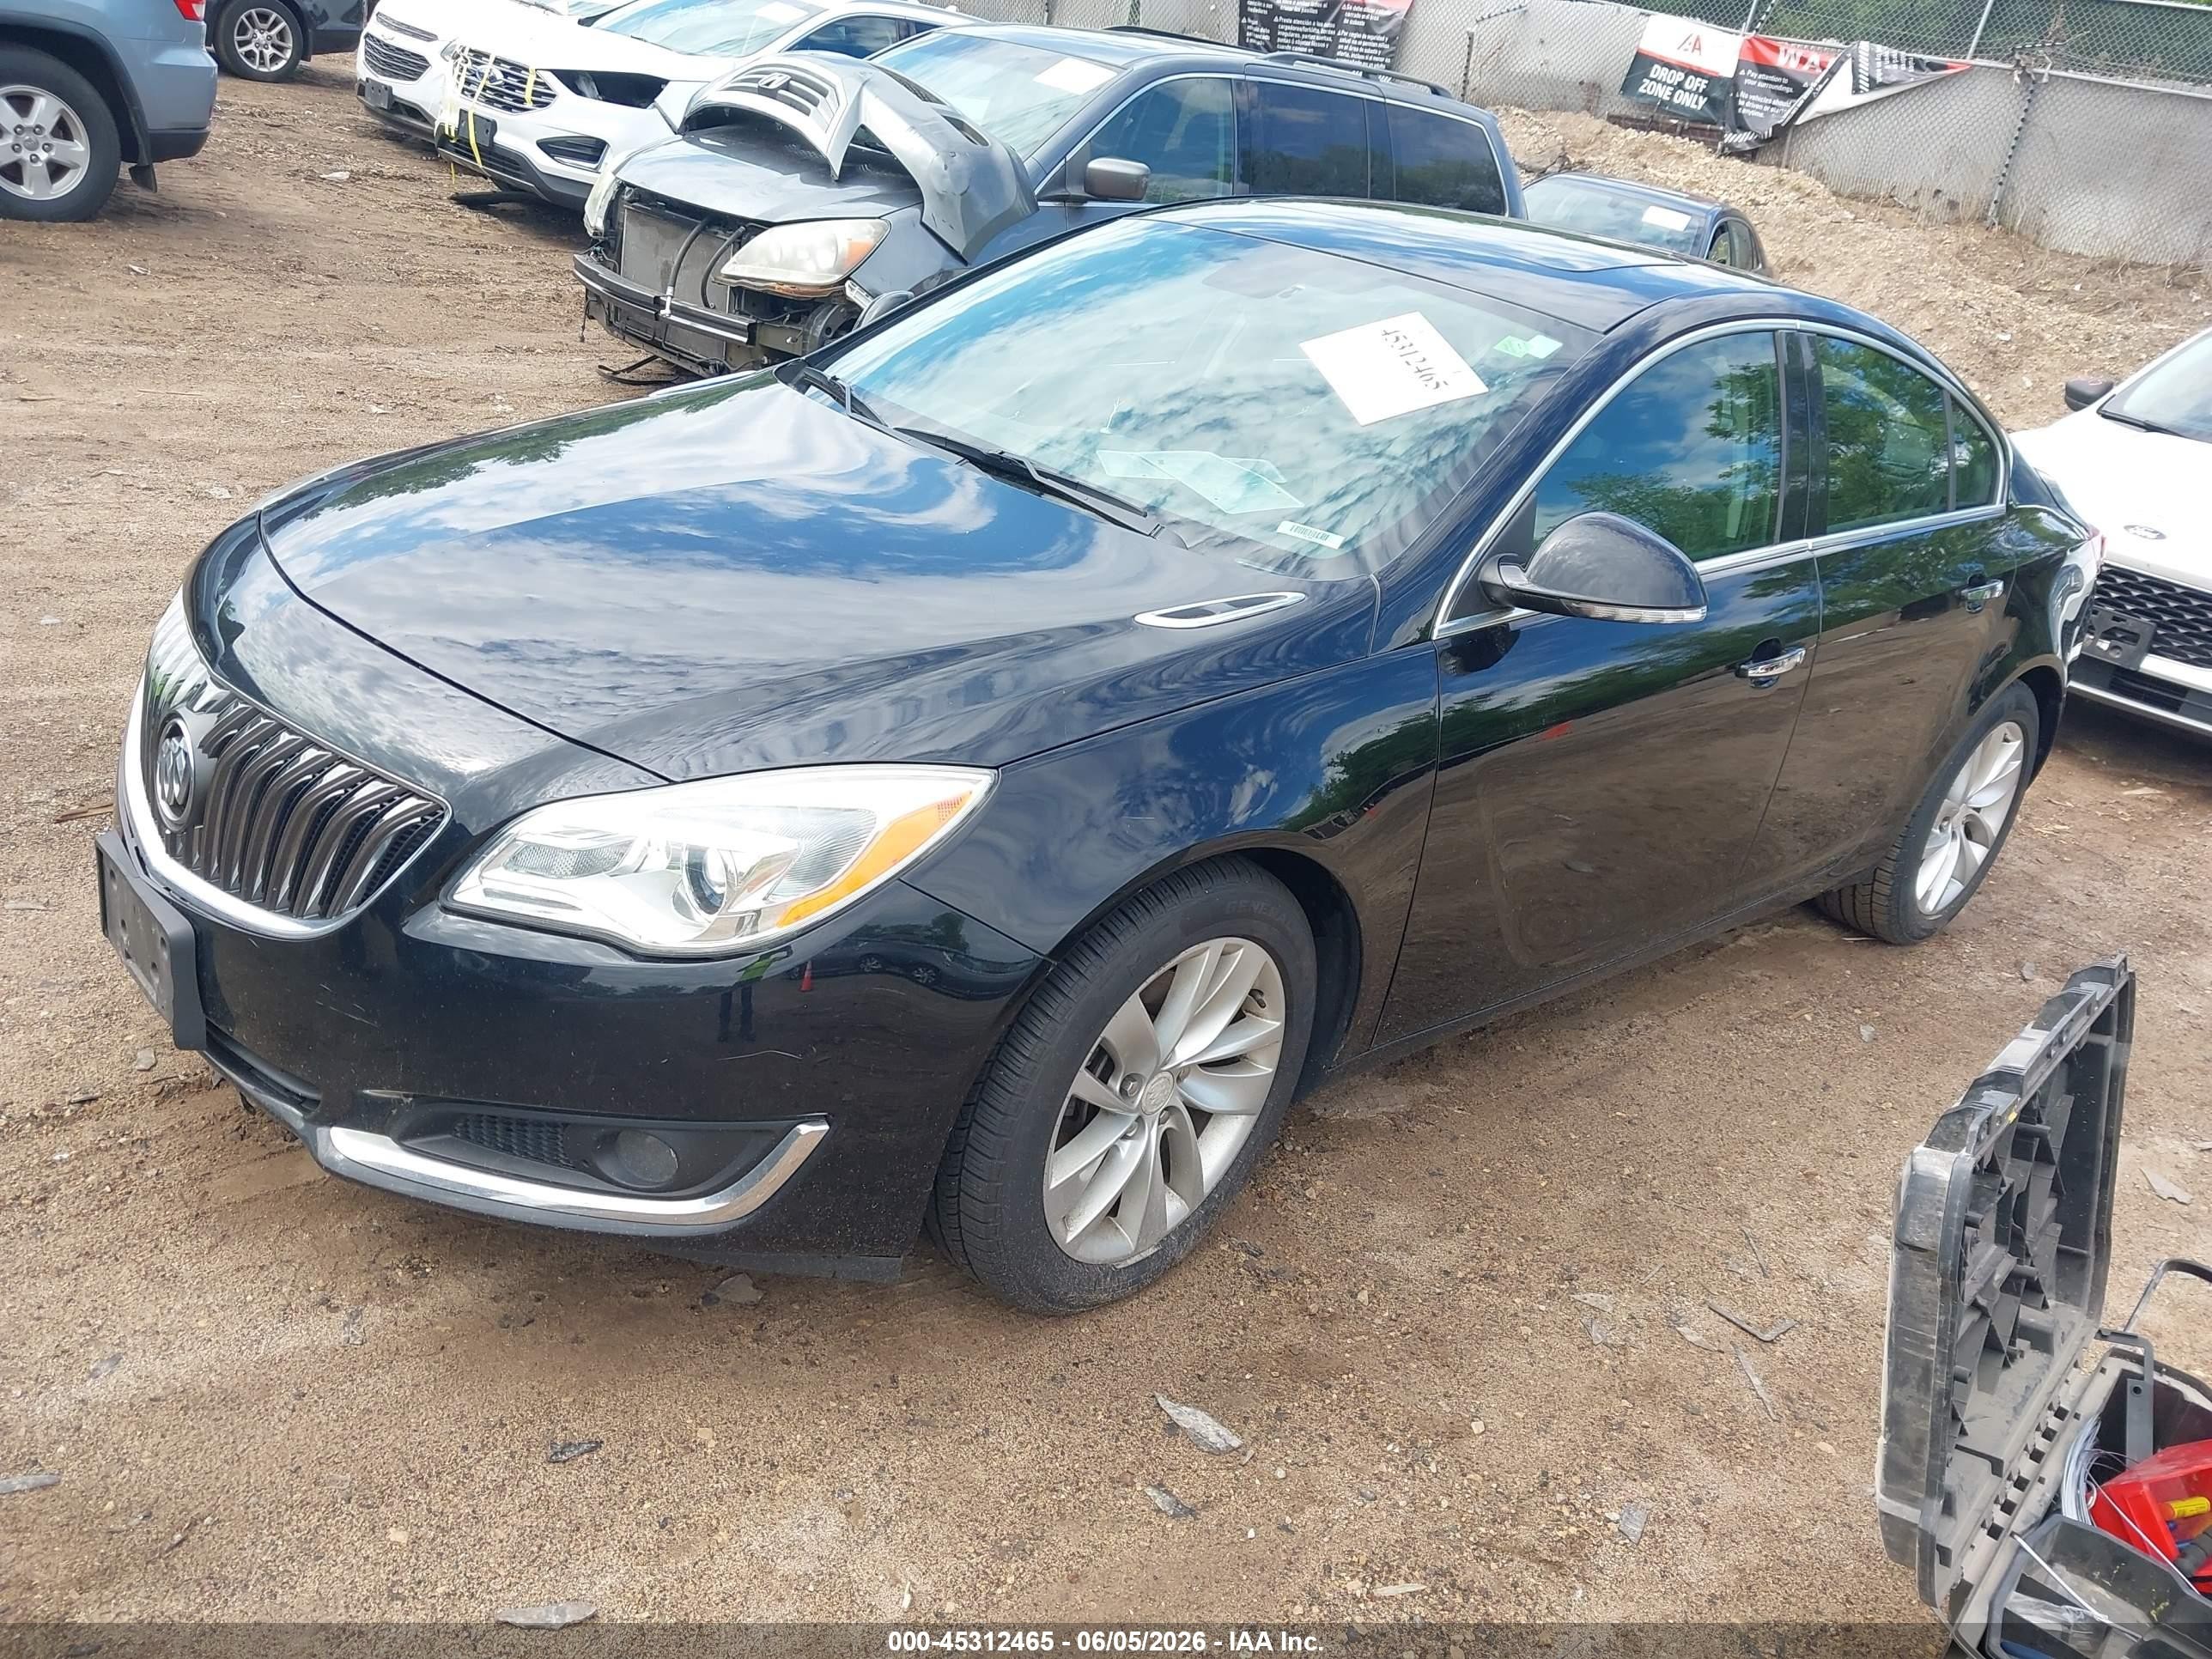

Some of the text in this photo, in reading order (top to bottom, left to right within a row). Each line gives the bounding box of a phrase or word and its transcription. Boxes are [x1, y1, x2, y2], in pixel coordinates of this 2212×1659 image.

[1649, 64, 1709, 93] DROP OFF
[1747, 69, 1757, 79] Pay
[1758, 72, 1782, 82] attention
[1638, 78, 1708, 110] ZONE ONLY
[1746, 101, 1763, 110] driven
